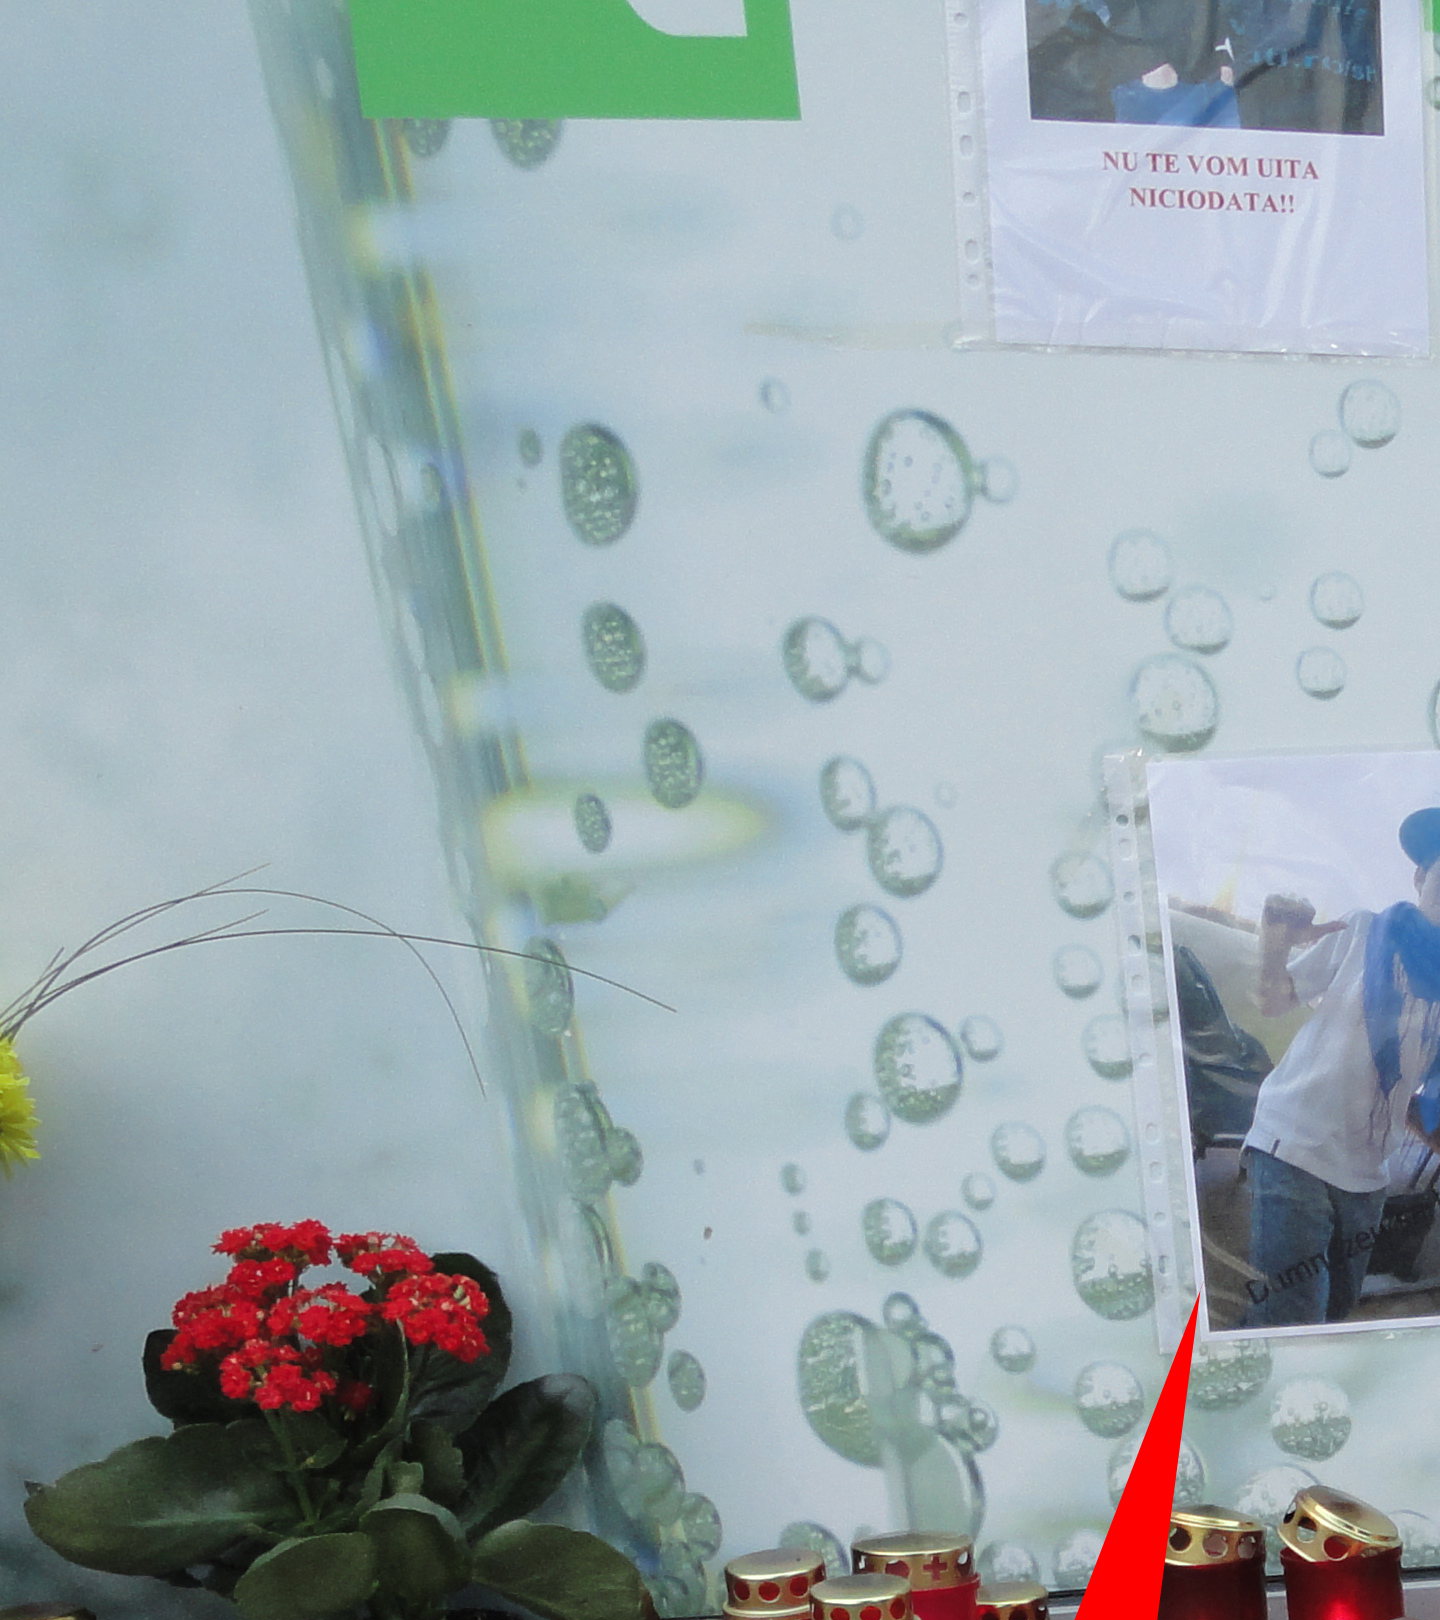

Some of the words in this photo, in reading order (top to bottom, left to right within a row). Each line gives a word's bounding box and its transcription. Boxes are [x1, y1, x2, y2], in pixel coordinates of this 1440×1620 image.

[1102, 150, 1139, 172] NU
[1146, 152, 1181, 174] TE
[1187, 154, 1250, 177] VOM
[1256, 158, 1319, 181] UITA
[1129, 187, 1296, 214] NICIODATA!!
